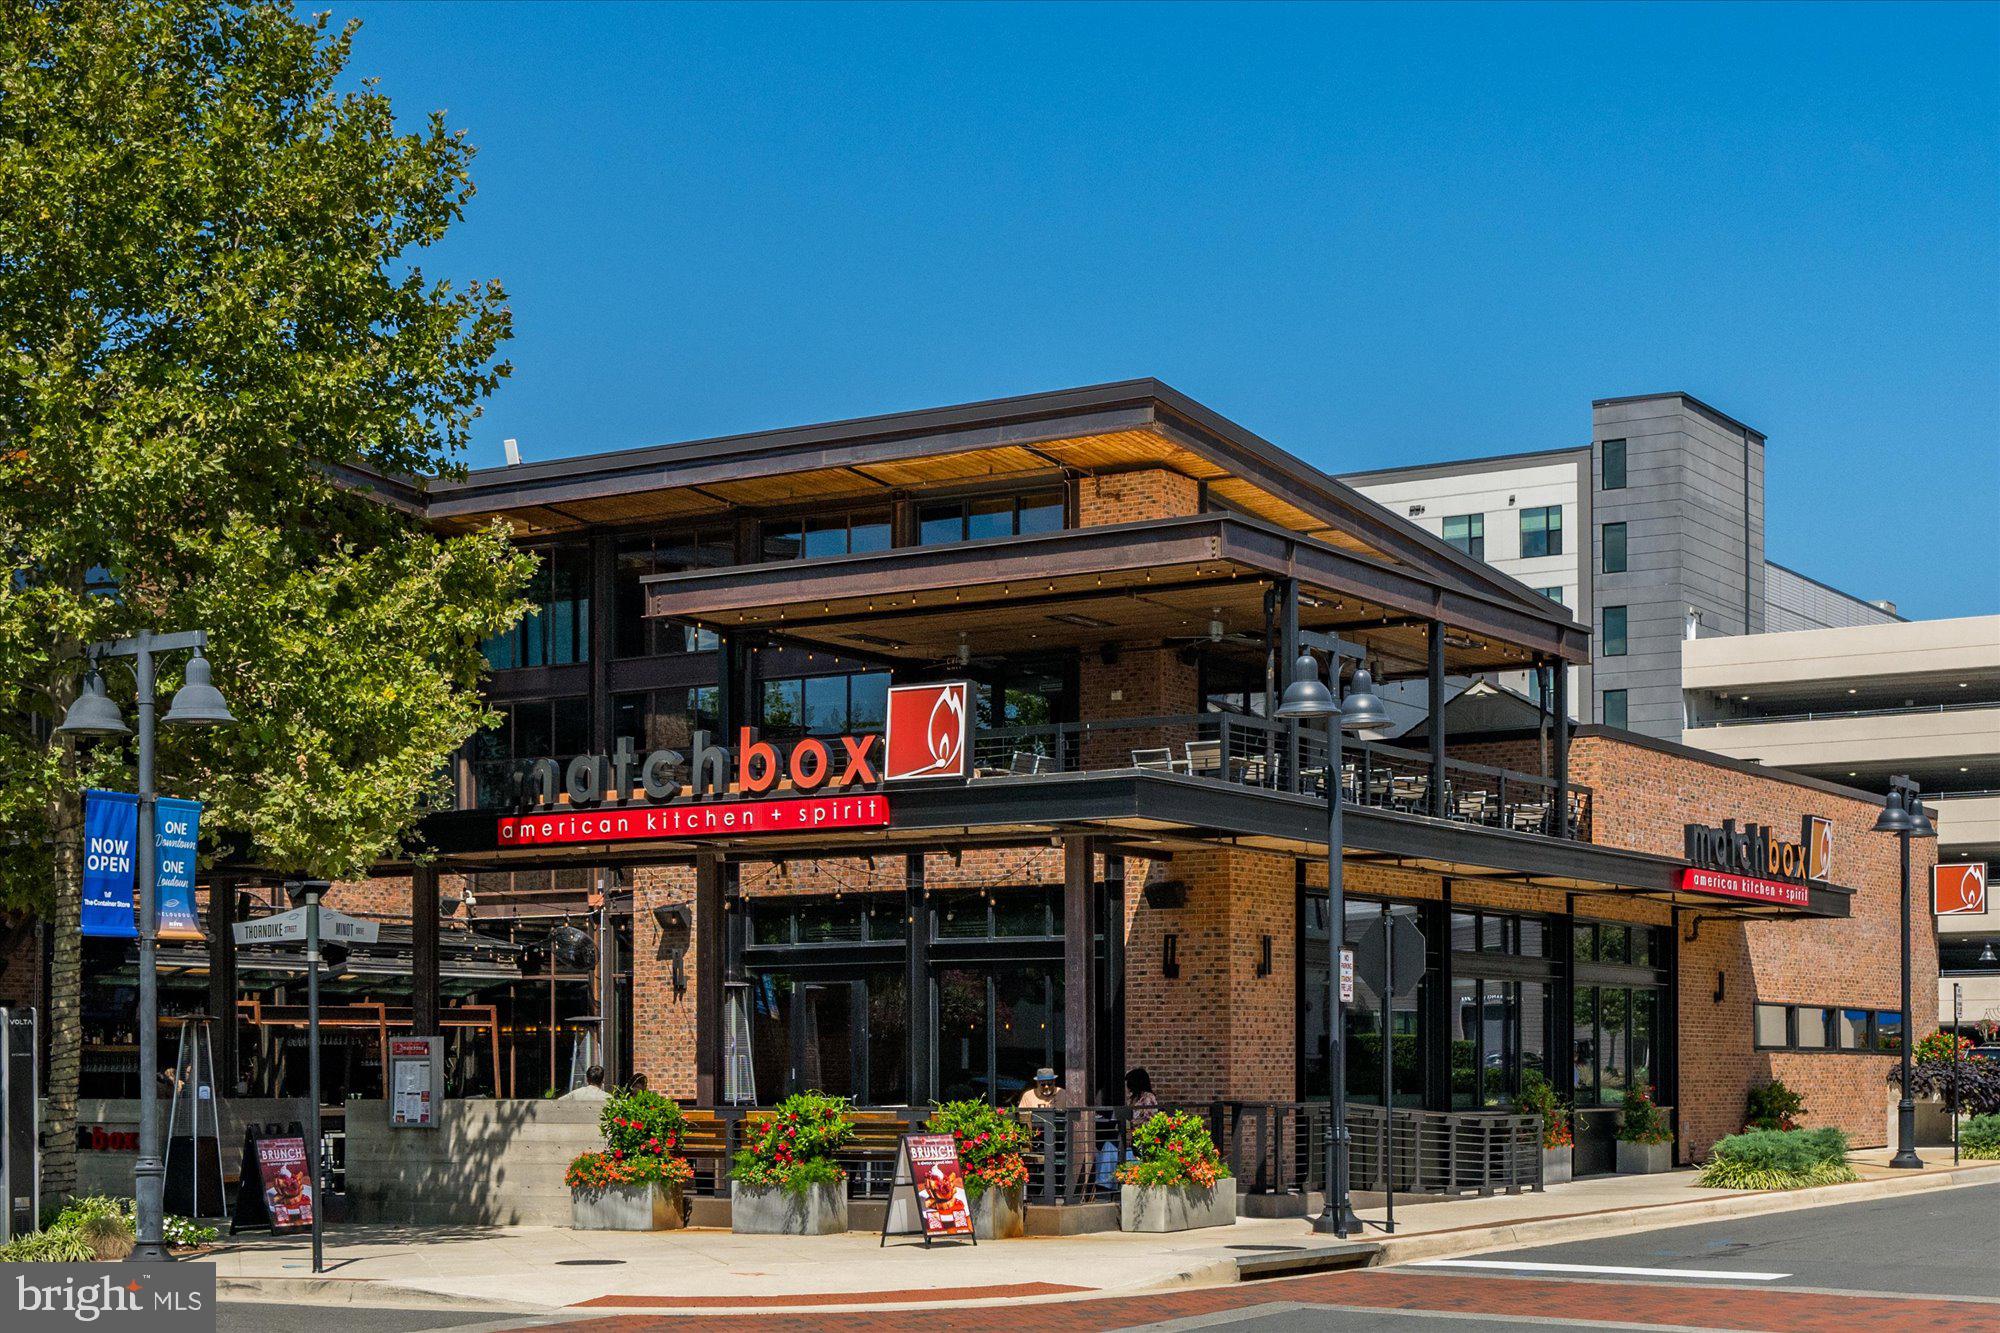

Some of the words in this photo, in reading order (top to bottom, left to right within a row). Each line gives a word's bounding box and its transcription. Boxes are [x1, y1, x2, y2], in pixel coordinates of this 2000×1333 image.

[510, 726, 886, 808] matchbox
[501, 817, 629, 839] american
[646, 808, 754, 831] kitchen
[771, 809, 782, 821] +
[799, 799, 876, 826] spirit
[164, 821, 188, 836] ONE
[91, 837, 129, 856] NOW
[155, 833, 196, 850] Downtown
[1685, 818, 1807, 880] matchbox
[87, 854, 130, 874] OPEN
[162, 860, 185, 874] ONE
[156, 874, 189, 888] Loudoun
[1692, 873, 1738, 891] american
[1741, 880, 1776, 897] kitchen
[1786, 888, 1809, 903] spirit
[84, 898, 93, 906] The
[93, 899, 117, 907] Container
[245, 923, 283, 940] THORNDIKE
[335, 922, 354, 937] MINOT
[262, 1149, 303, 1161] BRUNCH
[911, 1146, 955, 1159] BRUNCH
